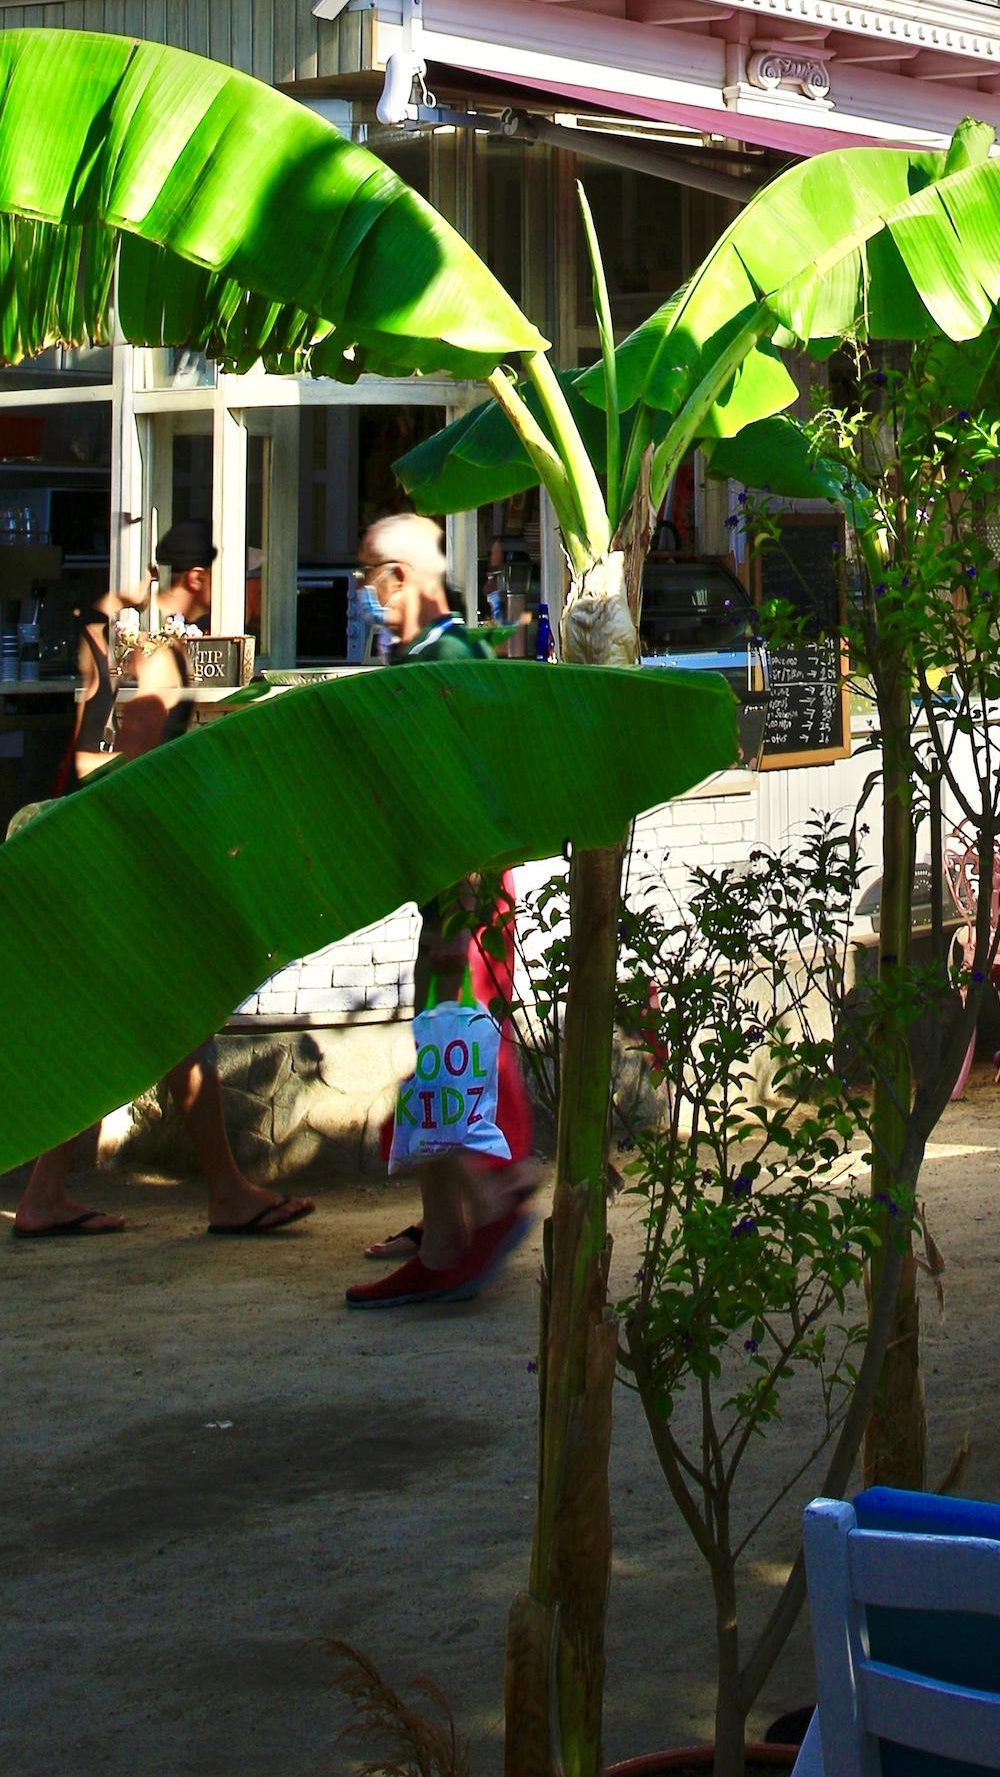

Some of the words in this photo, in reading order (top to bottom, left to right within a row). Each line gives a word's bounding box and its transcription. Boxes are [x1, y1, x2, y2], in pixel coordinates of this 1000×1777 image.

[194, 663, 225, 677] BOX
[197, 650, 223, 664] TIP
[406, 1039, 488, 1082] OOL
[395, 1086, 485, 1130] KIDZ
